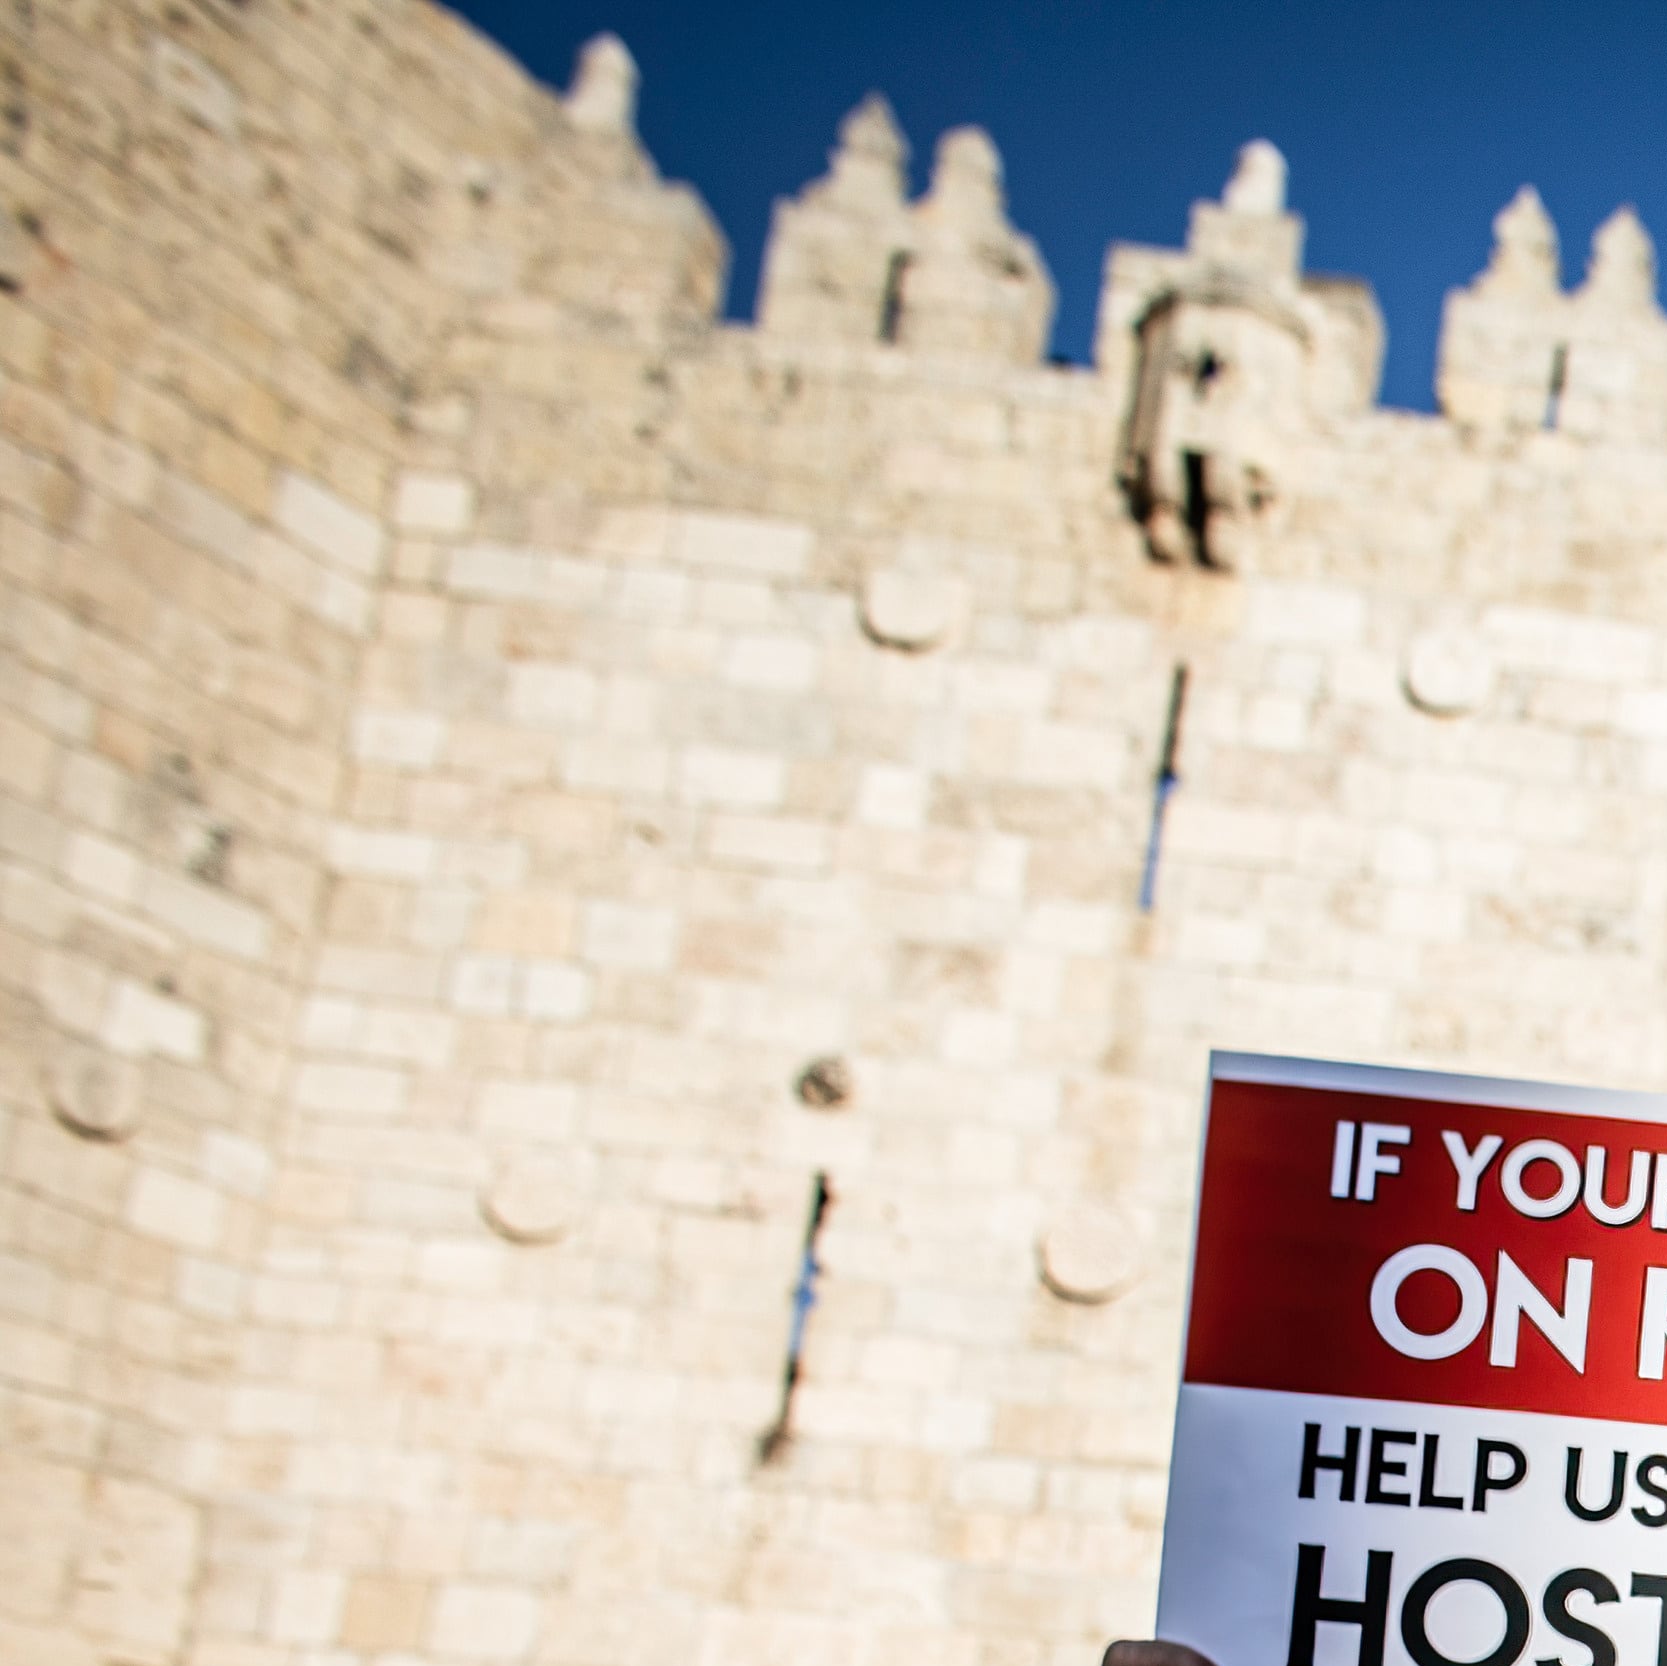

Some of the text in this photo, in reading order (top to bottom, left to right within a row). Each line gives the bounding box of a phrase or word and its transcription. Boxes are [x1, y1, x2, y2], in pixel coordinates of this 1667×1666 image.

[1330, 1120, 1411, 1201] IF
[1370, 1244, 1594, 1375] ON
[1298, 1422, 1528, 1513] HELP
